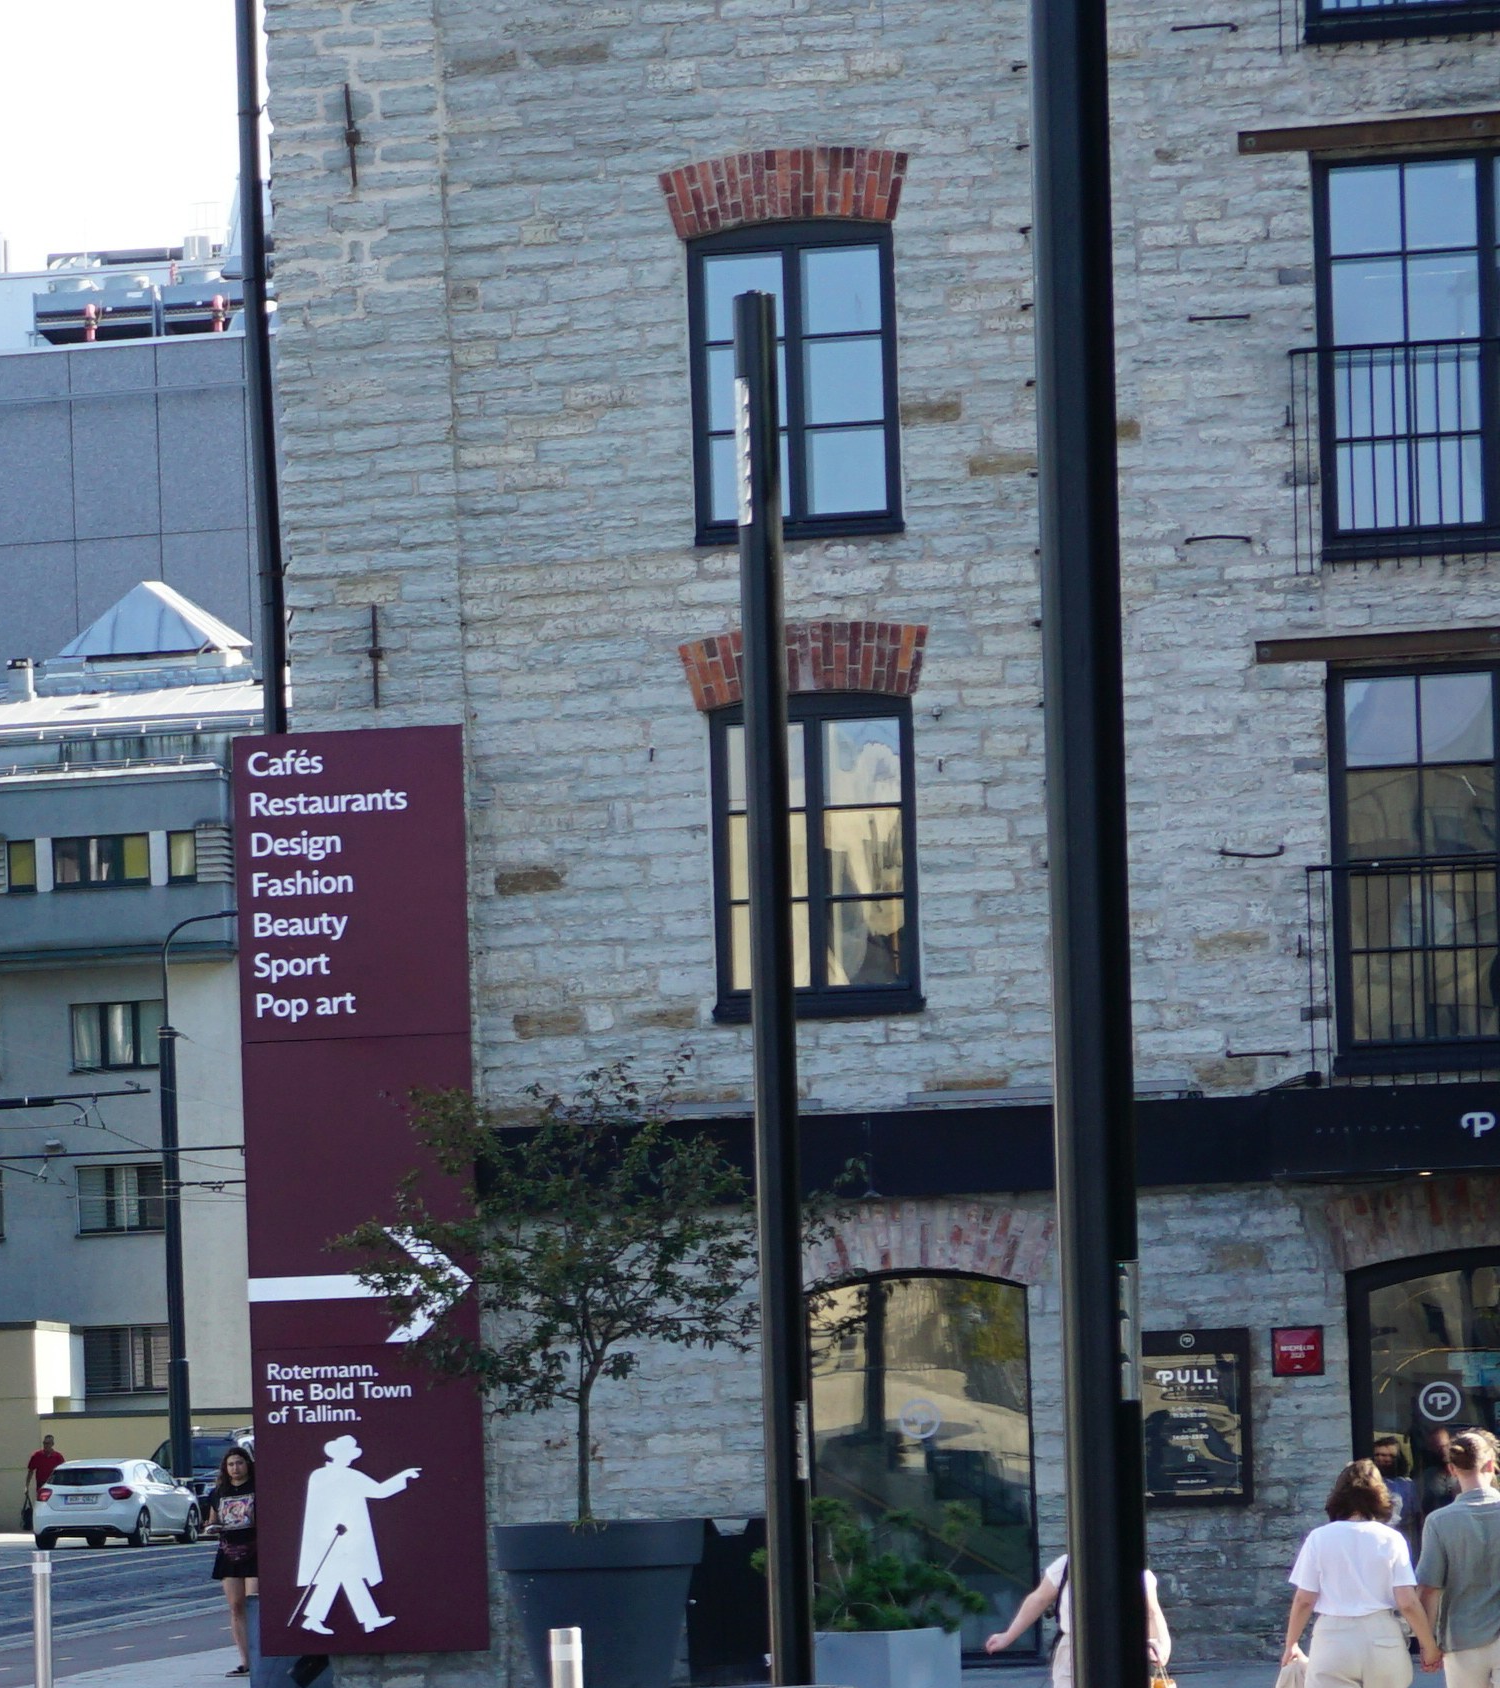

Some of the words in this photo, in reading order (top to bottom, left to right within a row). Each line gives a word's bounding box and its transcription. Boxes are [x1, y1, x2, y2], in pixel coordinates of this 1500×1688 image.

[247, 750, 324, 777] Cafés
[249, 789, 408, 817] Restaurants
[250, 831, 342, 861] Design
[252, 870, 354, 898] Fashion
[253, 911, 348, 942] Beauty
[254, 951, 331, 982] Sport
[255, 992, 309, 1022] Pop
[316, 991, 357, 1015] art
[267, 1362, 379, 1381] Rotermann.
[1156, 1369, 1219, 1385] PULL
[267, 1384, 304, 1402] The
[309, 1382, 354, 1401] Bold
[360, 1381, 412, 1399] Town
[267, 1406, 289, 1424] of
[294, 1404, 362, 1423] Tallinn.
